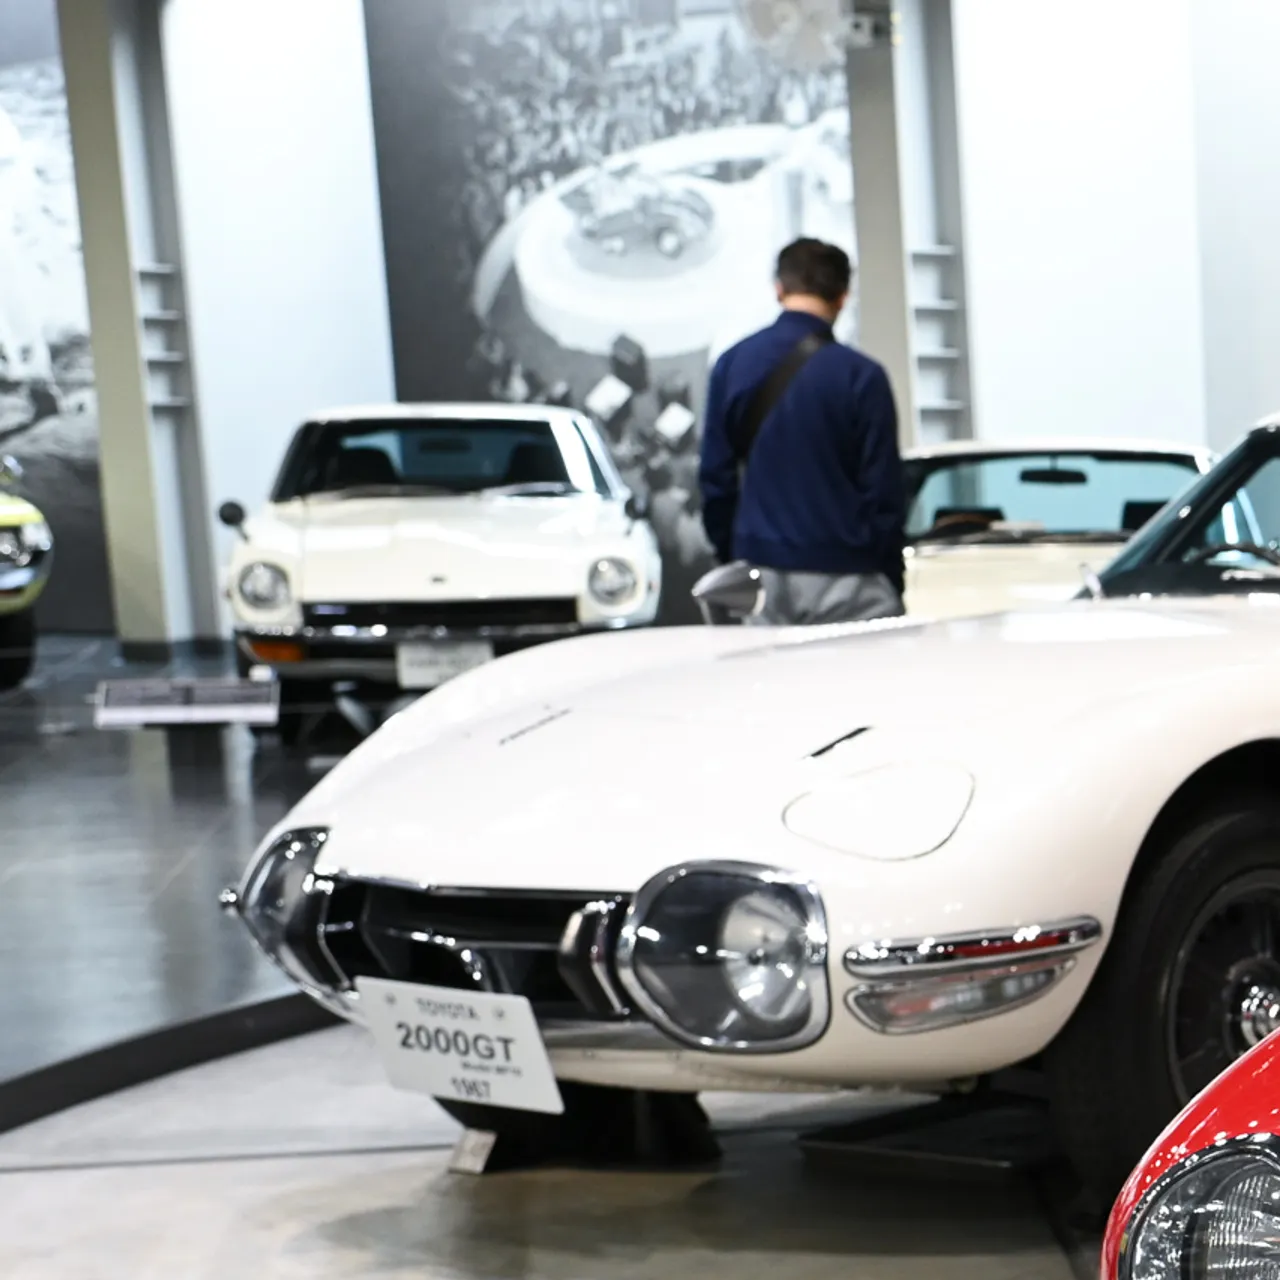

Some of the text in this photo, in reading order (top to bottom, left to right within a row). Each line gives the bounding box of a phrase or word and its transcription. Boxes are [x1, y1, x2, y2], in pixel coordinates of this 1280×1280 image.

[415, 996, 481, 1021] TOYOTA
[396, 1022, 515, 1062] 2000GT
[450, 1077, 492, 1099] 1967
